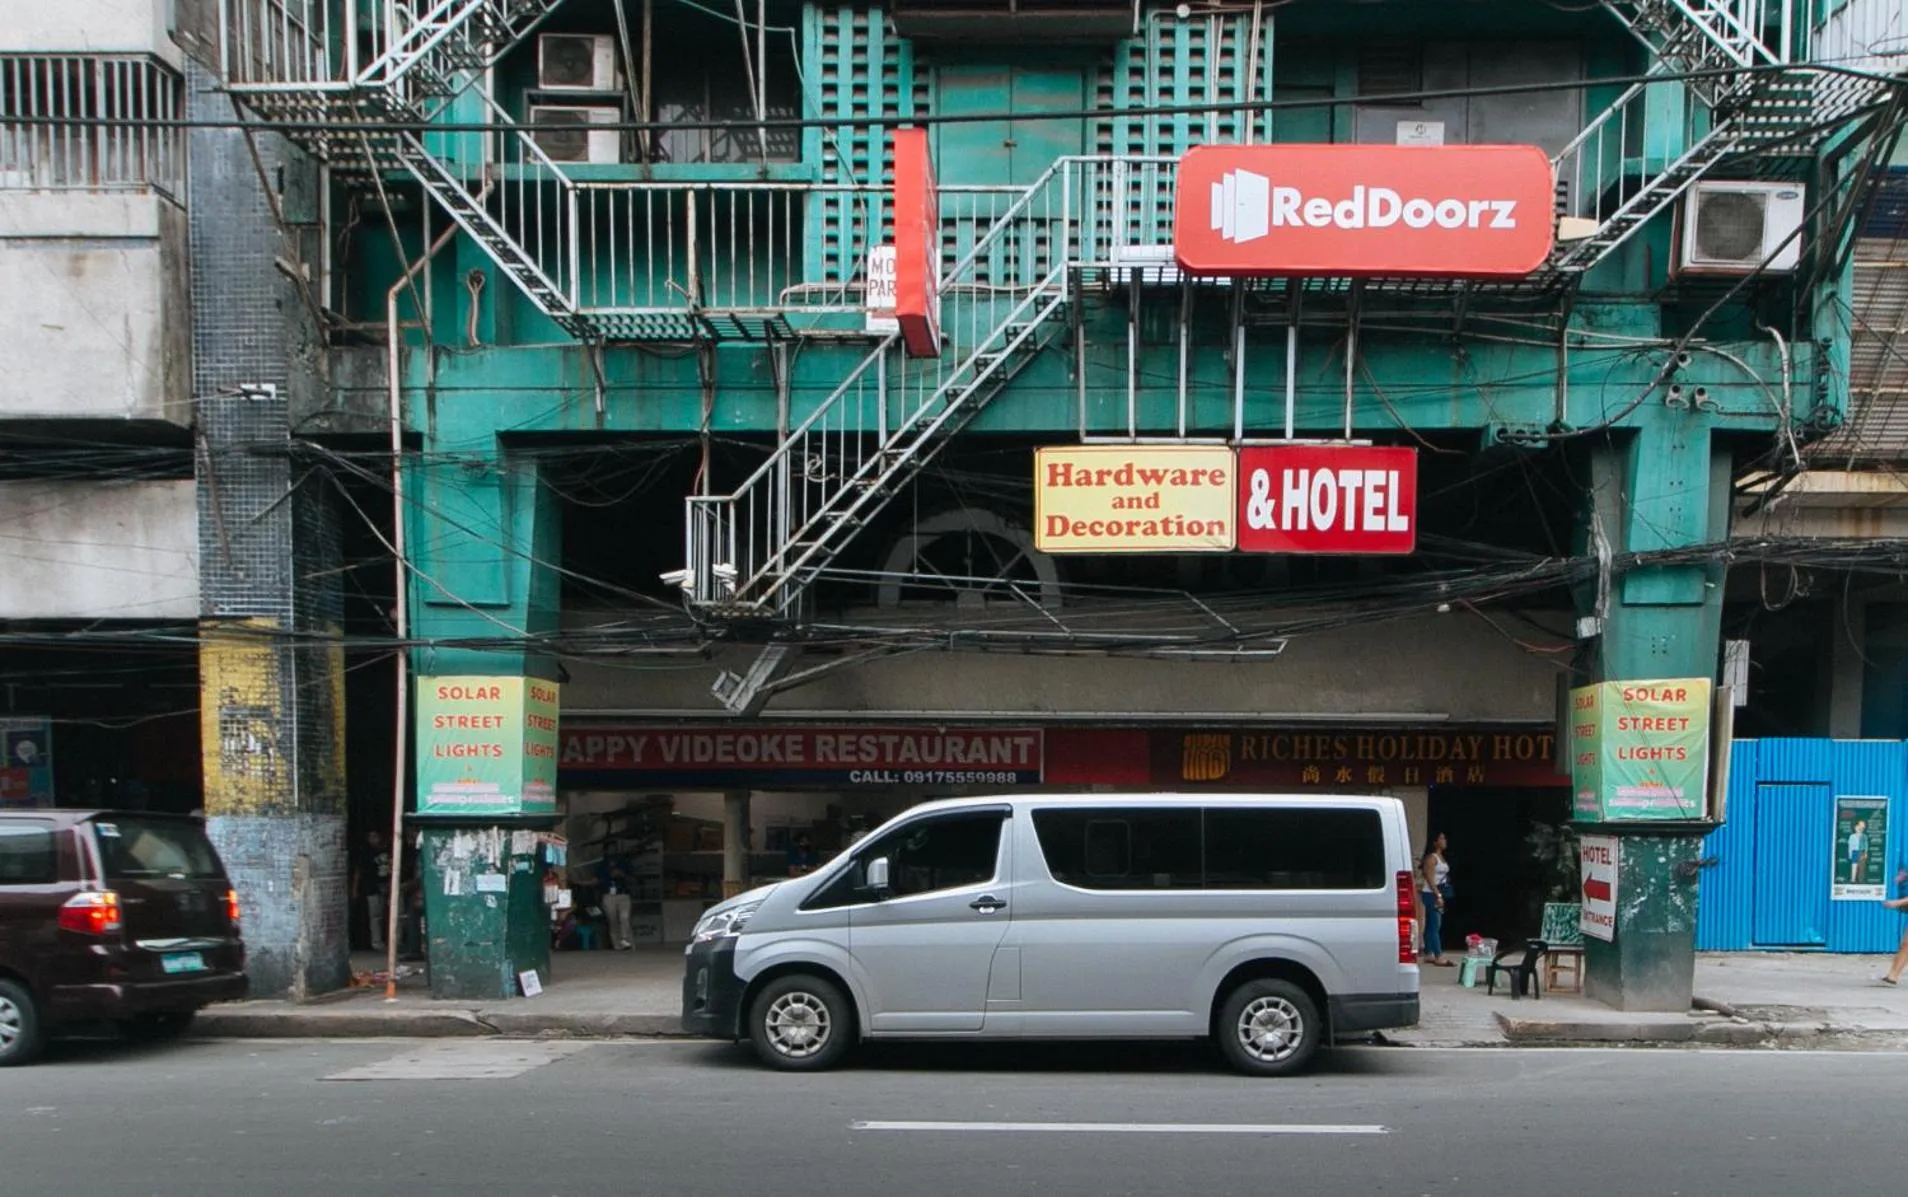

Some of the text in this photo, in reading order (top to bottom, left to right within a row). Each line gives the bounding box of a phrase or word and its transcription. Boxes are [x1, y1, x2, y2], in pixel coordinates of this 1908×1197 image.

[1272, 185, 1517, 229] RedDoorz
[1046, 463, 1225, 488] Hardware
[1111, 492, 1160, 510] and
[1247, 467, 1409, 532] & HOTEL
[1046, 514, 1226, 537] Decoration
[438, 686, 500, 700] SOLAR
[1623, 687, 1687, 702] SOLAR
[434, 715, 504, 729] STREET
[1618, 717, 1689, 731] STREET
[434, 744, 502, 757] LIGHTS
[658, 735, 804, 763] VIDEOKE
[815, 735, 1034, 764] RESTAURANT
[1241, 735, 1347, 760] RICHES
[1356, 735, 1484, 761] HOLIDAY
[1618, 747, 1687, 761] LIGHTS
[850, 770, 1017, 784] CALL: 09175559988
[1582, 845, 1611, 865] HOTEL
